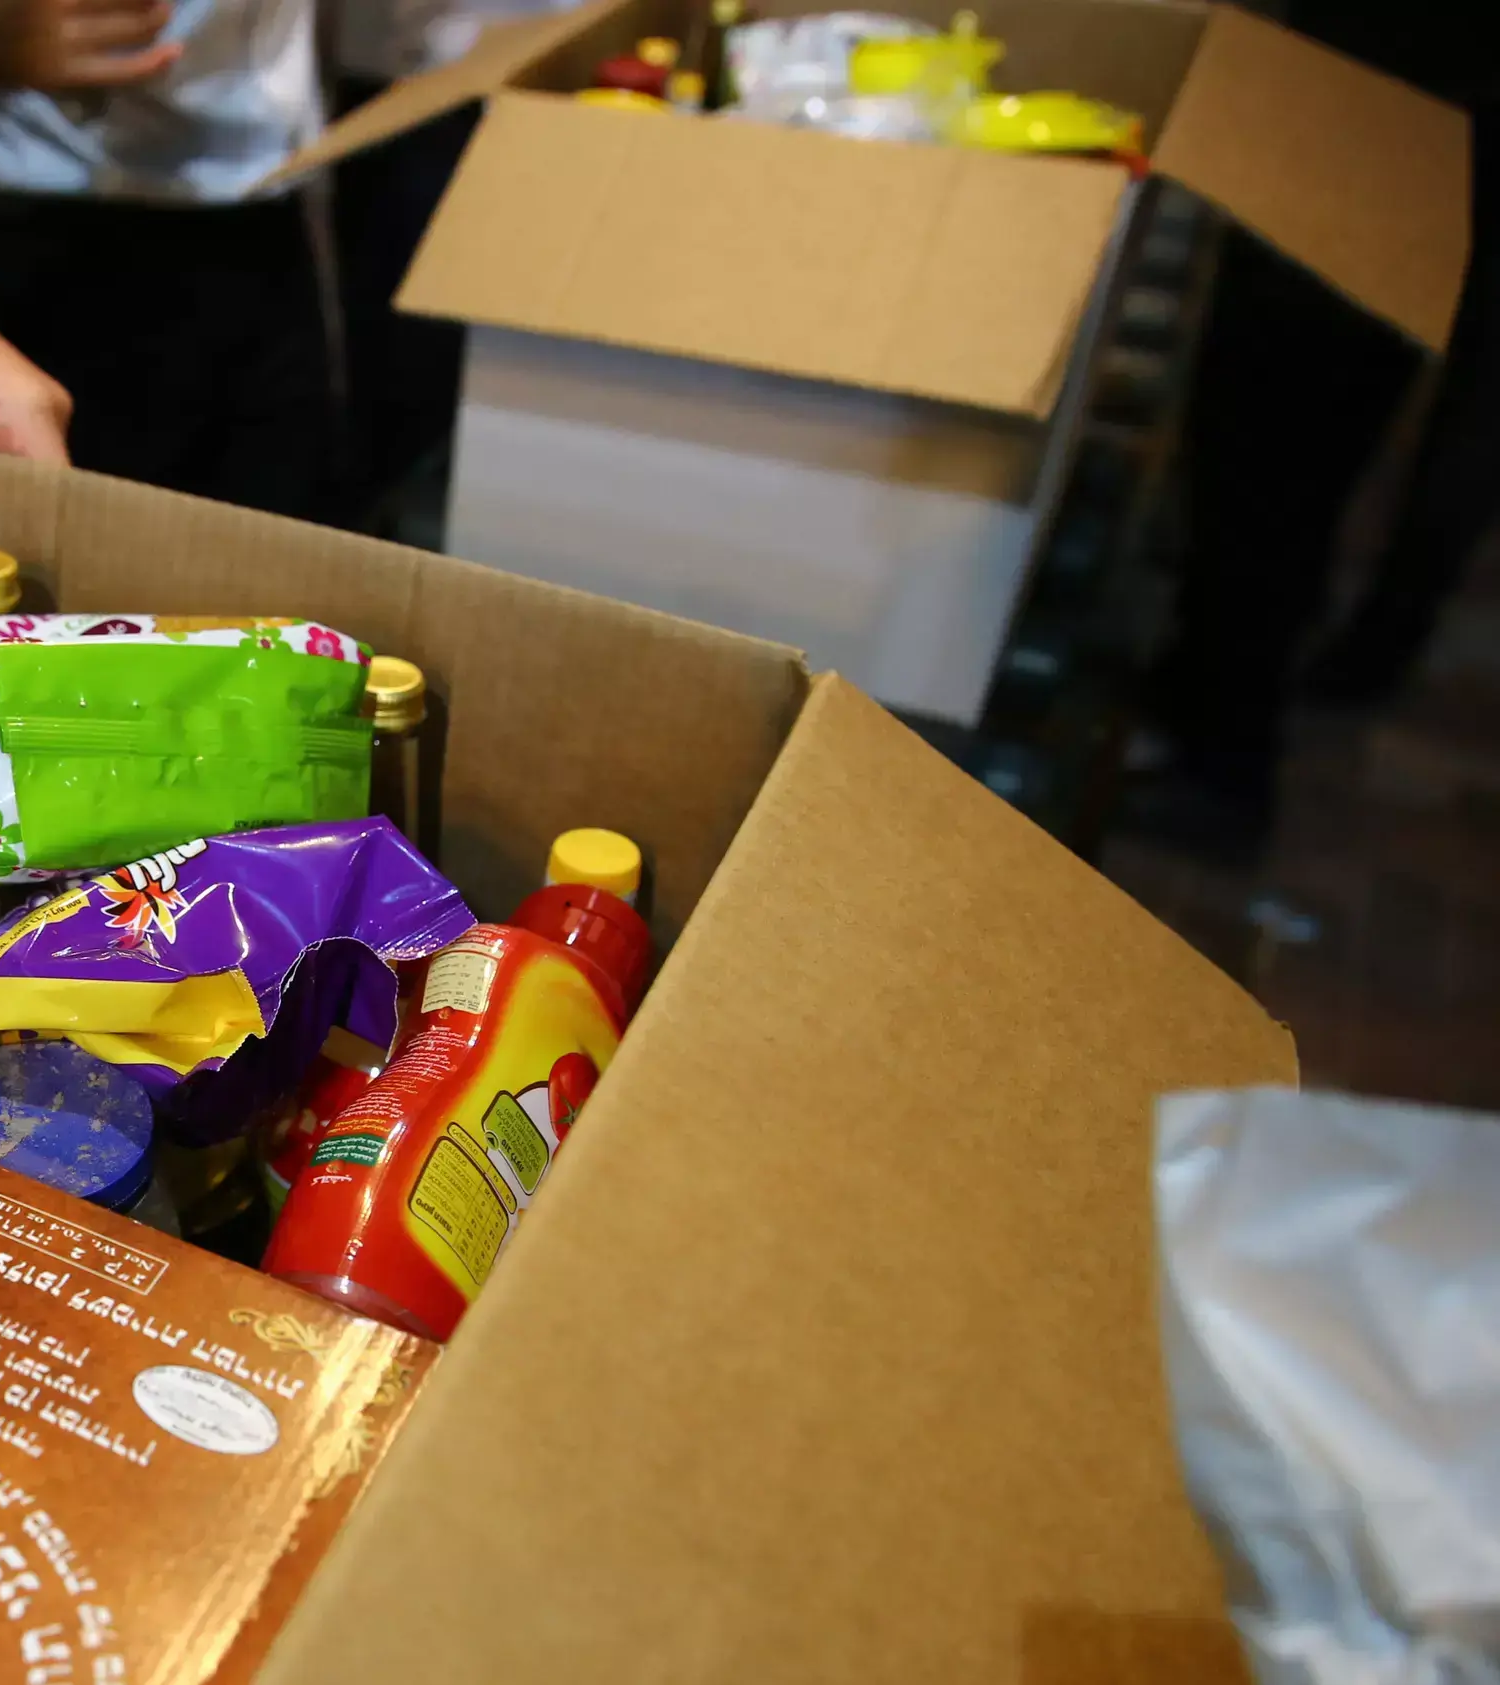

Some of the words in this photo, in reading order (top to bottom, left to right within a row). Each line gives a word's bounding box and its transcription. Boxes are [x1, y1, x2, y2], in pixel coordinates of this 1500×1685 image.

[27, 1213, 45, 1223] oz
[50, 1223, 82, 1241] 70.4
[71, 1247, 85, 1259] 2
[124, 1253, 154, 1271] Net
[39, 1336, 90, 1367] כדין
[68, 1289, 188, 1347] לשמירת
[191, 1339, 305, 1400] הטריות
[5, 1353, 100, 1404] ושביעית
[5, 1385, 40, 1411] מן
[40, 1402, 156, 1466] המהדרין
